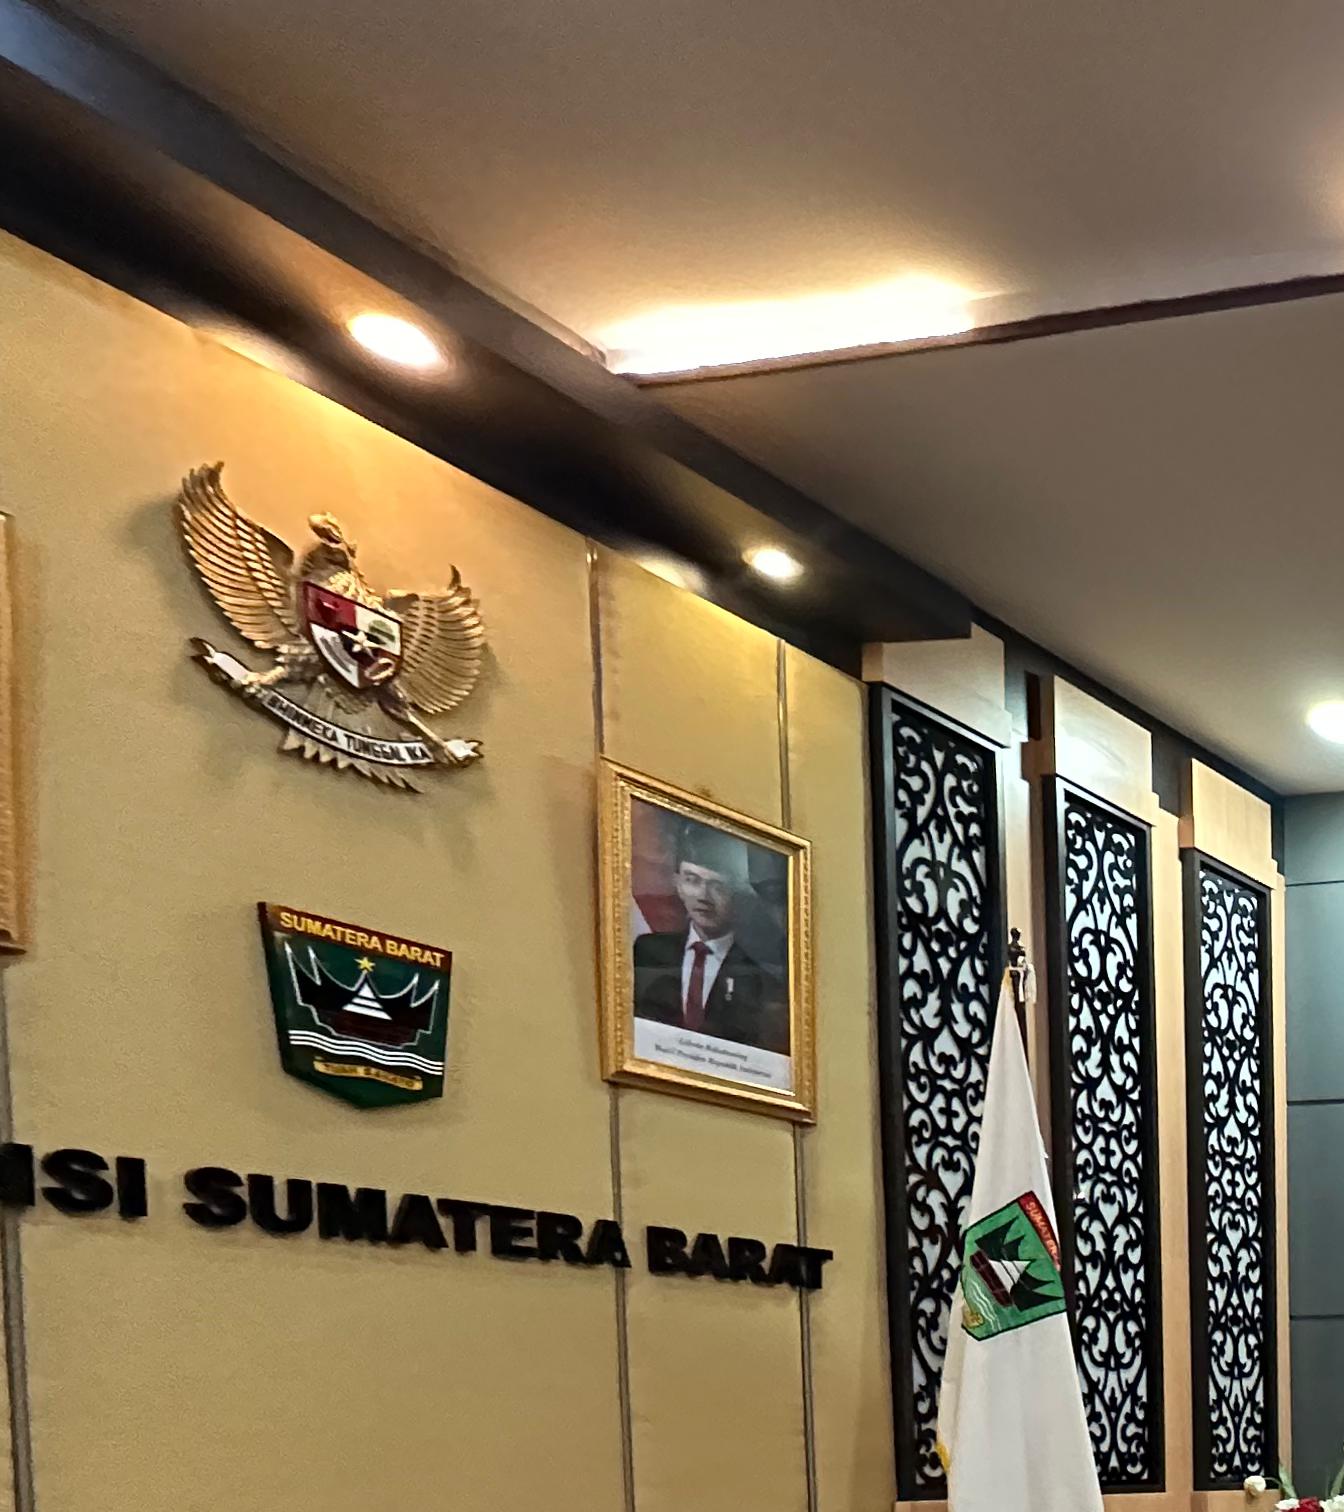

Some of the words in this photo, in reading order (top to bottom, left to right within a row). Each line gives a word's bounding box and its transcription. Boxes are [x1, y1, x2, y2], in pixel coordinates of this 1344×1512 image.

[280, 911, 383, 953] SUMATERA
[385, 939, 445, 968] BARAT
[183, 1166, 632, 1269] SUMATERA
[646, 1225, 834, 1290] BARAT
